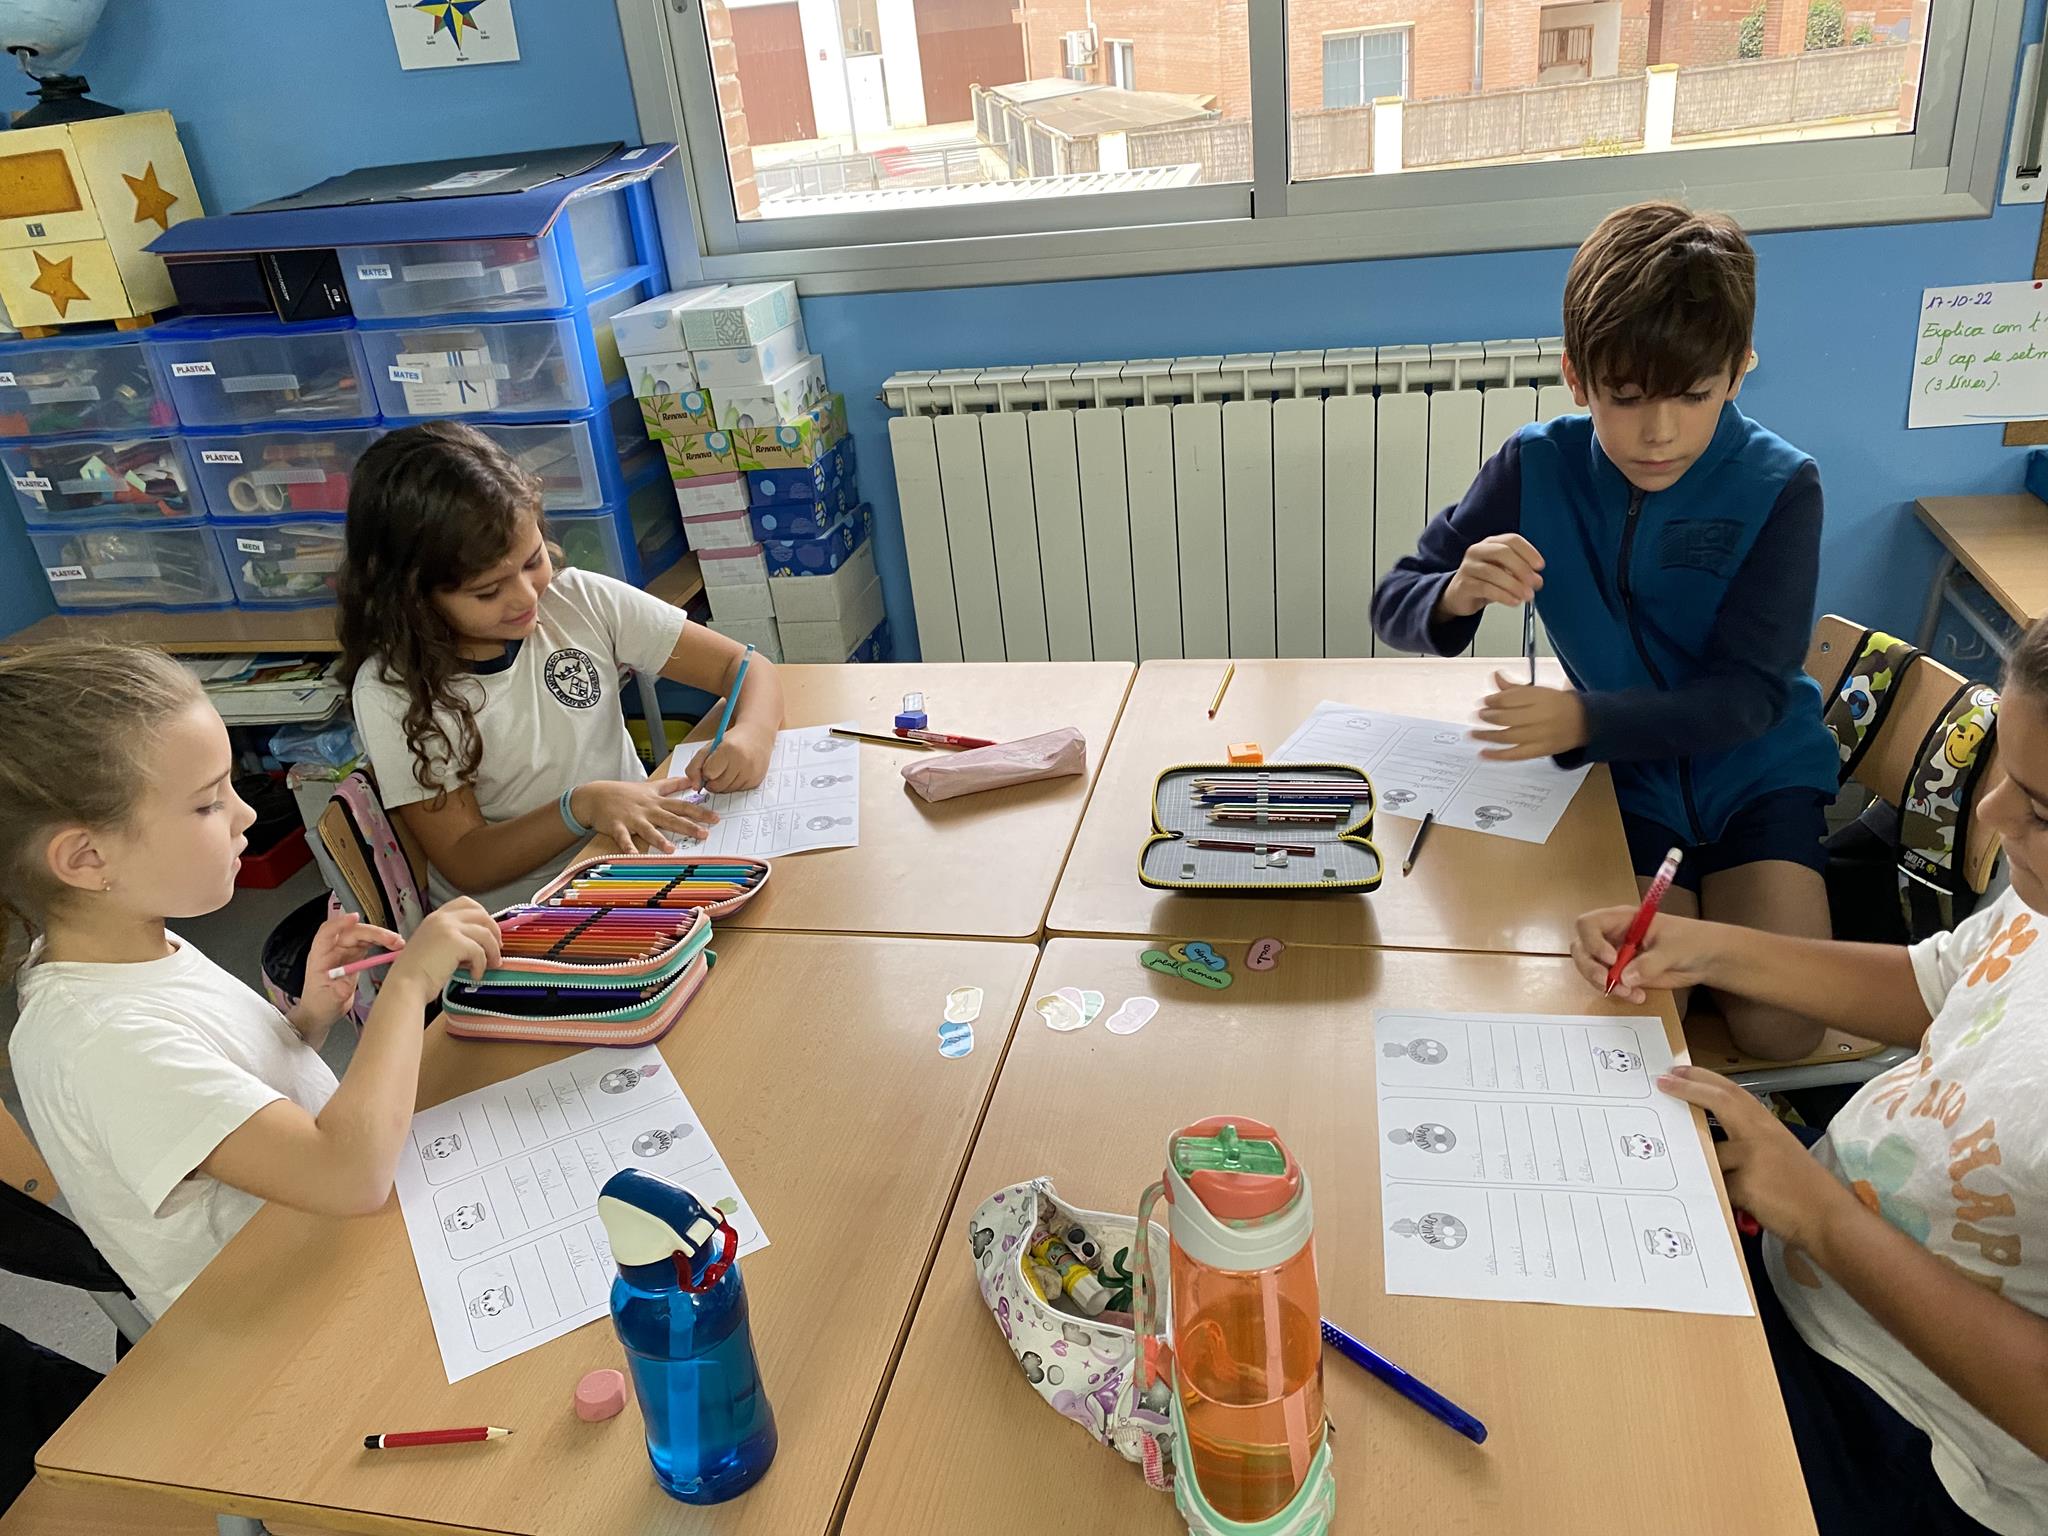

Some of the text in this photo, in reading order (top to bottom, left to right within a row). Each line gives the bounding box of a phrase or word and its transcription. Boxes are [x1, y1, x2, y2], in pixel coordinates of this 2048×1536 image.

[361, 268, 388, 277] MATES
[1925, 291, 1993, 310] 17-10-22
[1922, 320, 1985, 348] Explica
[1920, 347, 1943, 365] el
[1948, 354, 1976, 371] cap
[1983, 350, 2001, 363] de
[393, 370, 420, 380] MATES
[662, 412, 688, 421] Renova
[685, 451, 712, 460] Renova
[755, 445, 782, 453] Renova
[242, 543, 260, 551] MEDI
[1187, 967, 1223, 984] cámara
[1415, 1125, 1431, 1150] LLANAS
[1421, 1214, 1441, 1244] AGUDAS
